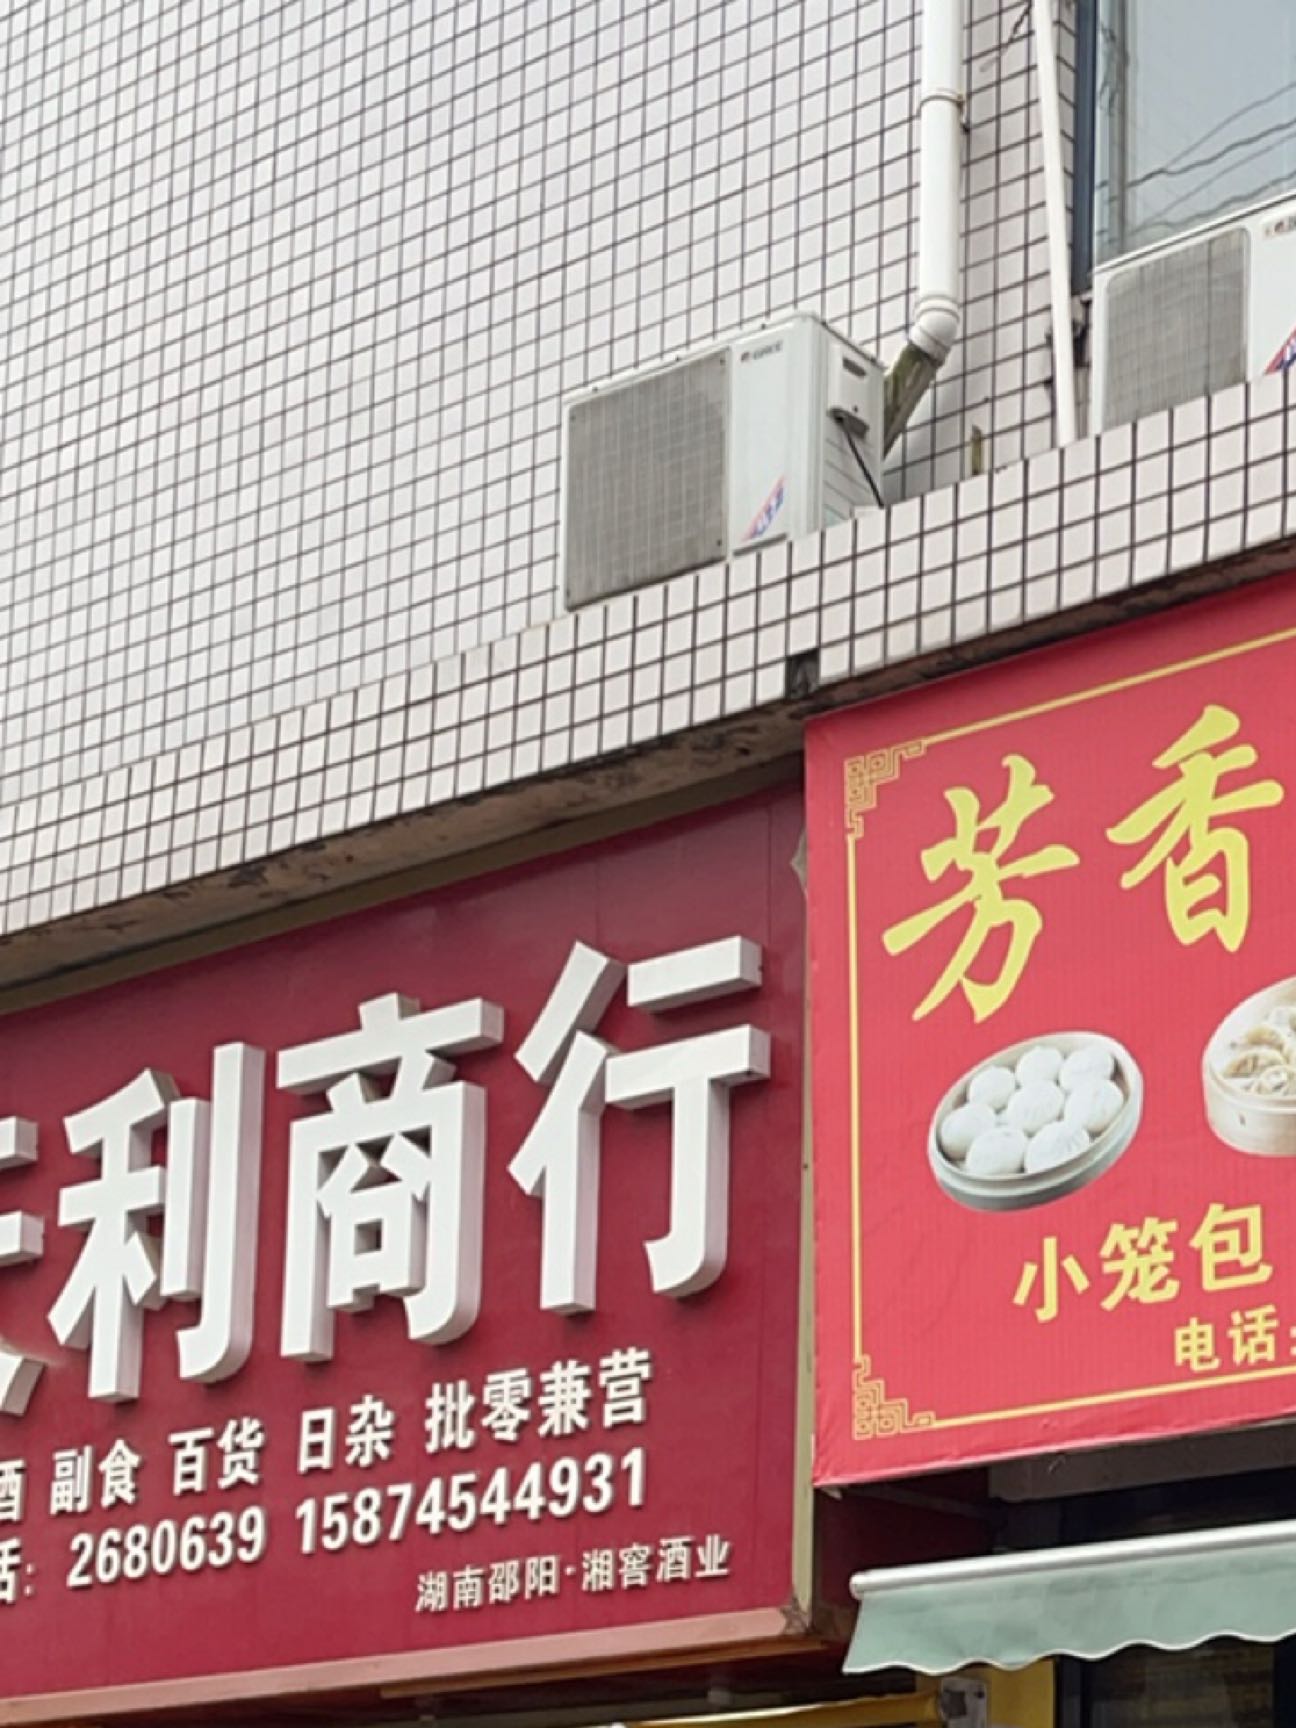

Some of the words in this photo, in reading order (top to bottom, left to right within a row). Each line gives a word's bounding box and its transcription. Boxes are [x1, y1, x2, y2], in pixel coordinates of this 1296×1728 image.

[1013, 1203, 1273, 1322] 小笼包
[50, 1439, 142, 1517] 副食
[168, 1416, 265, 1496] 百货
[297, 1394, 394, 1475] 日杂
[424, 1346, 654, 1455] 批零兼营
[66, 1505, 266, 1589] 2680639
[296, 1446, 648, 1556] 15874544931
